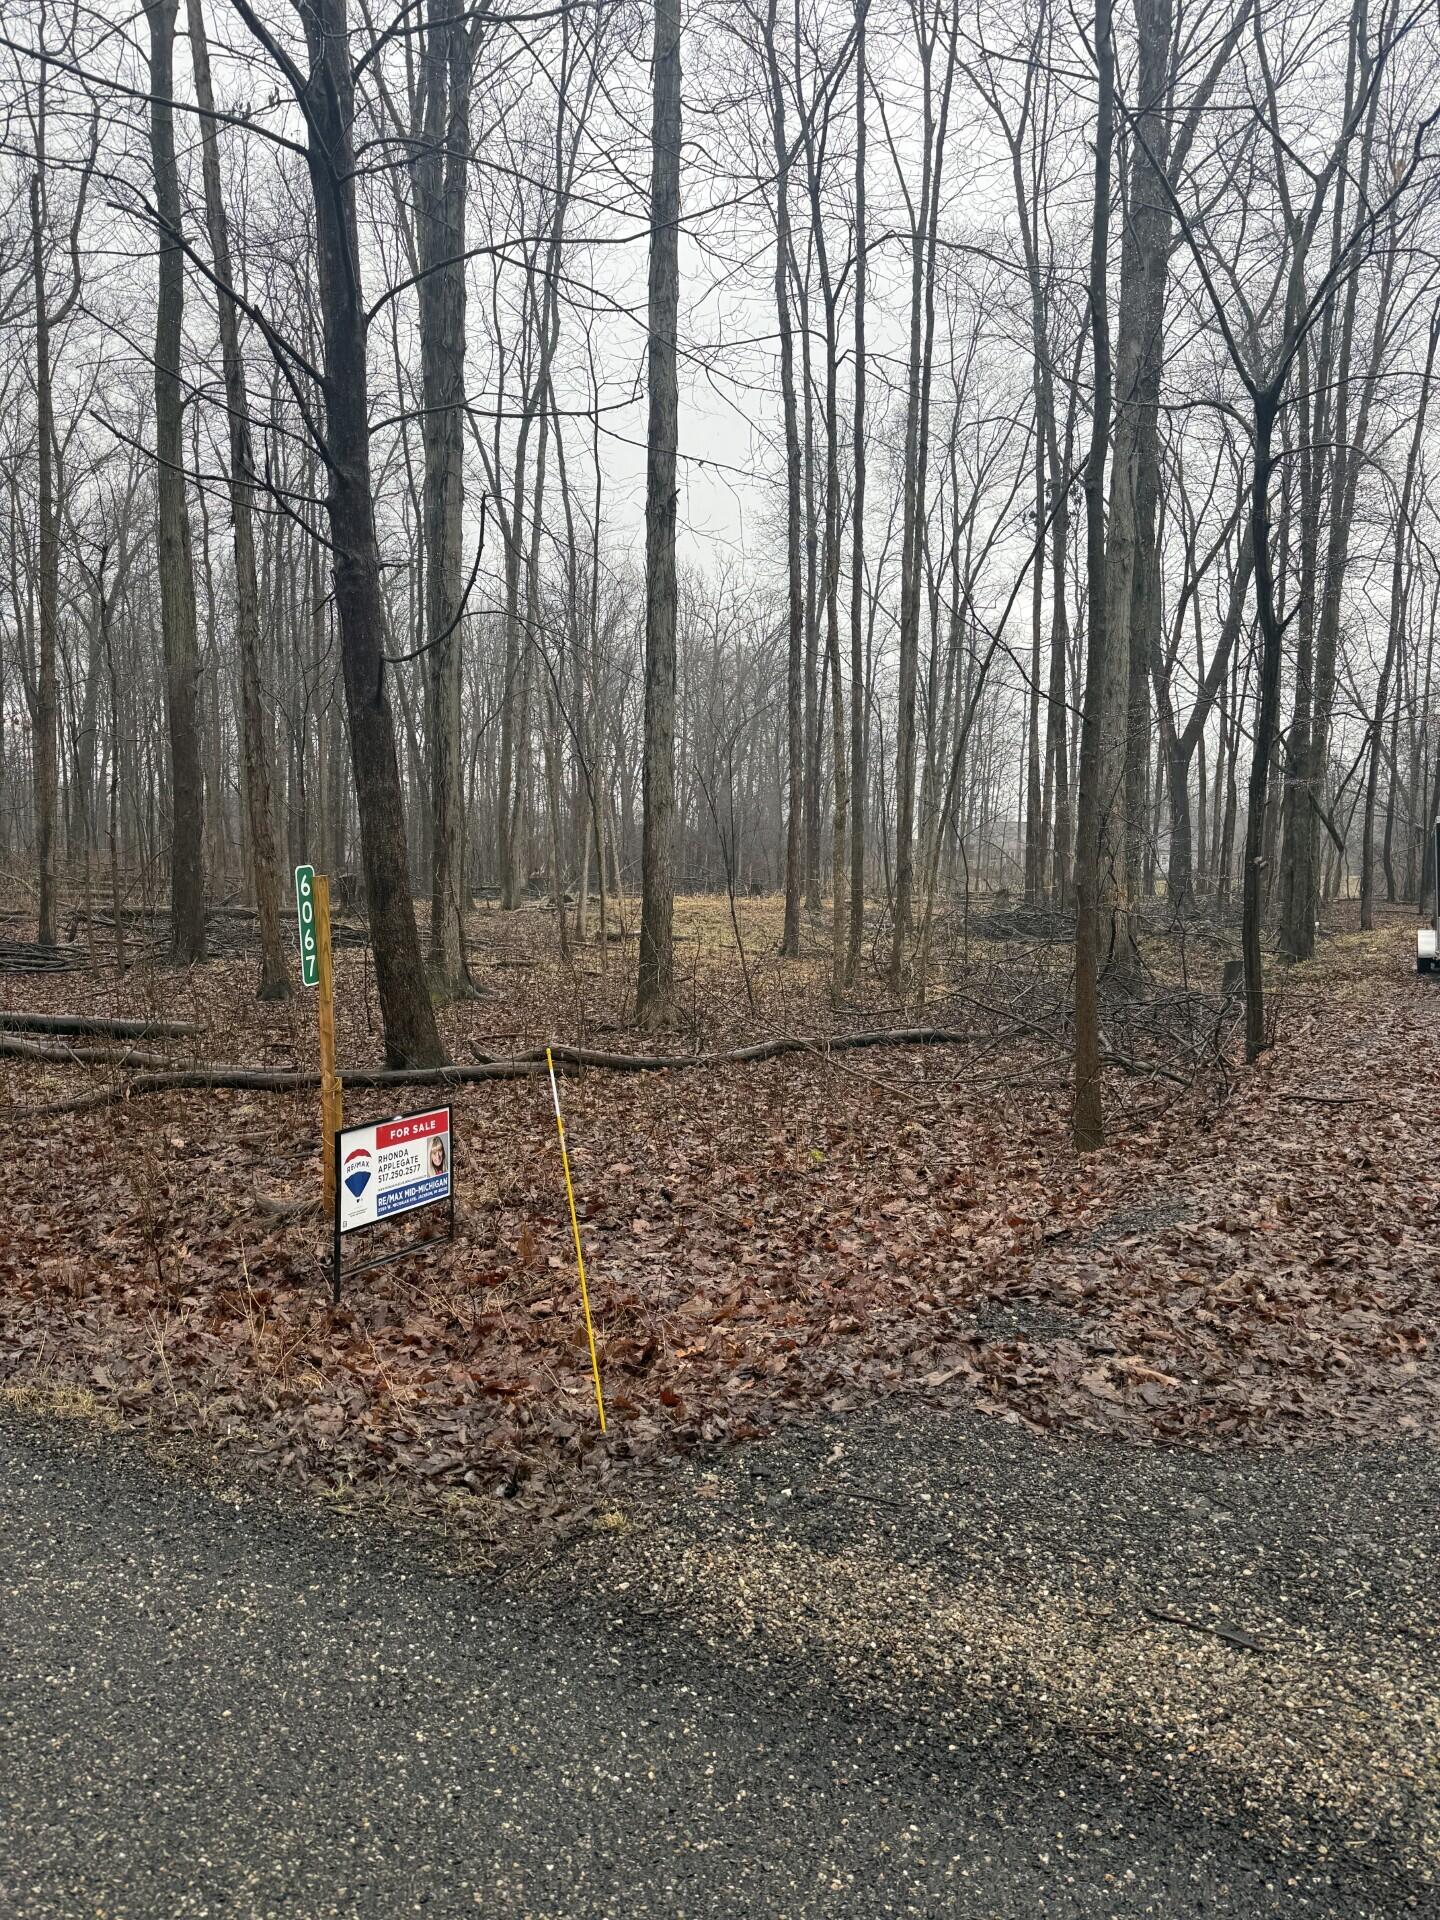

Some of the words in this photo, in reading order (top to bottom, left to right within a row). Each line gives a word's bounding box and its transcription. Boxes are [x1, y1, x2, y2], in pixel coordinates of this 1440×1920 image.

[300, 874, 316, 977] 6067
[390, 1127, 410, 1140] FOR
[412, 1120, 436, 1134] SALE
[378, 1148, 409, 1164] RHONDA
[378, 1155, 419, 1173] APPLEGATE
[346, 1160, 370, 1173] RE/MAX
[378, 1164, 421, 1183] 517.250.2577
[378, 1191, 404, 1207] RE/MAX
[404, 1176, 448, 1198] MID-MICHIGAN
